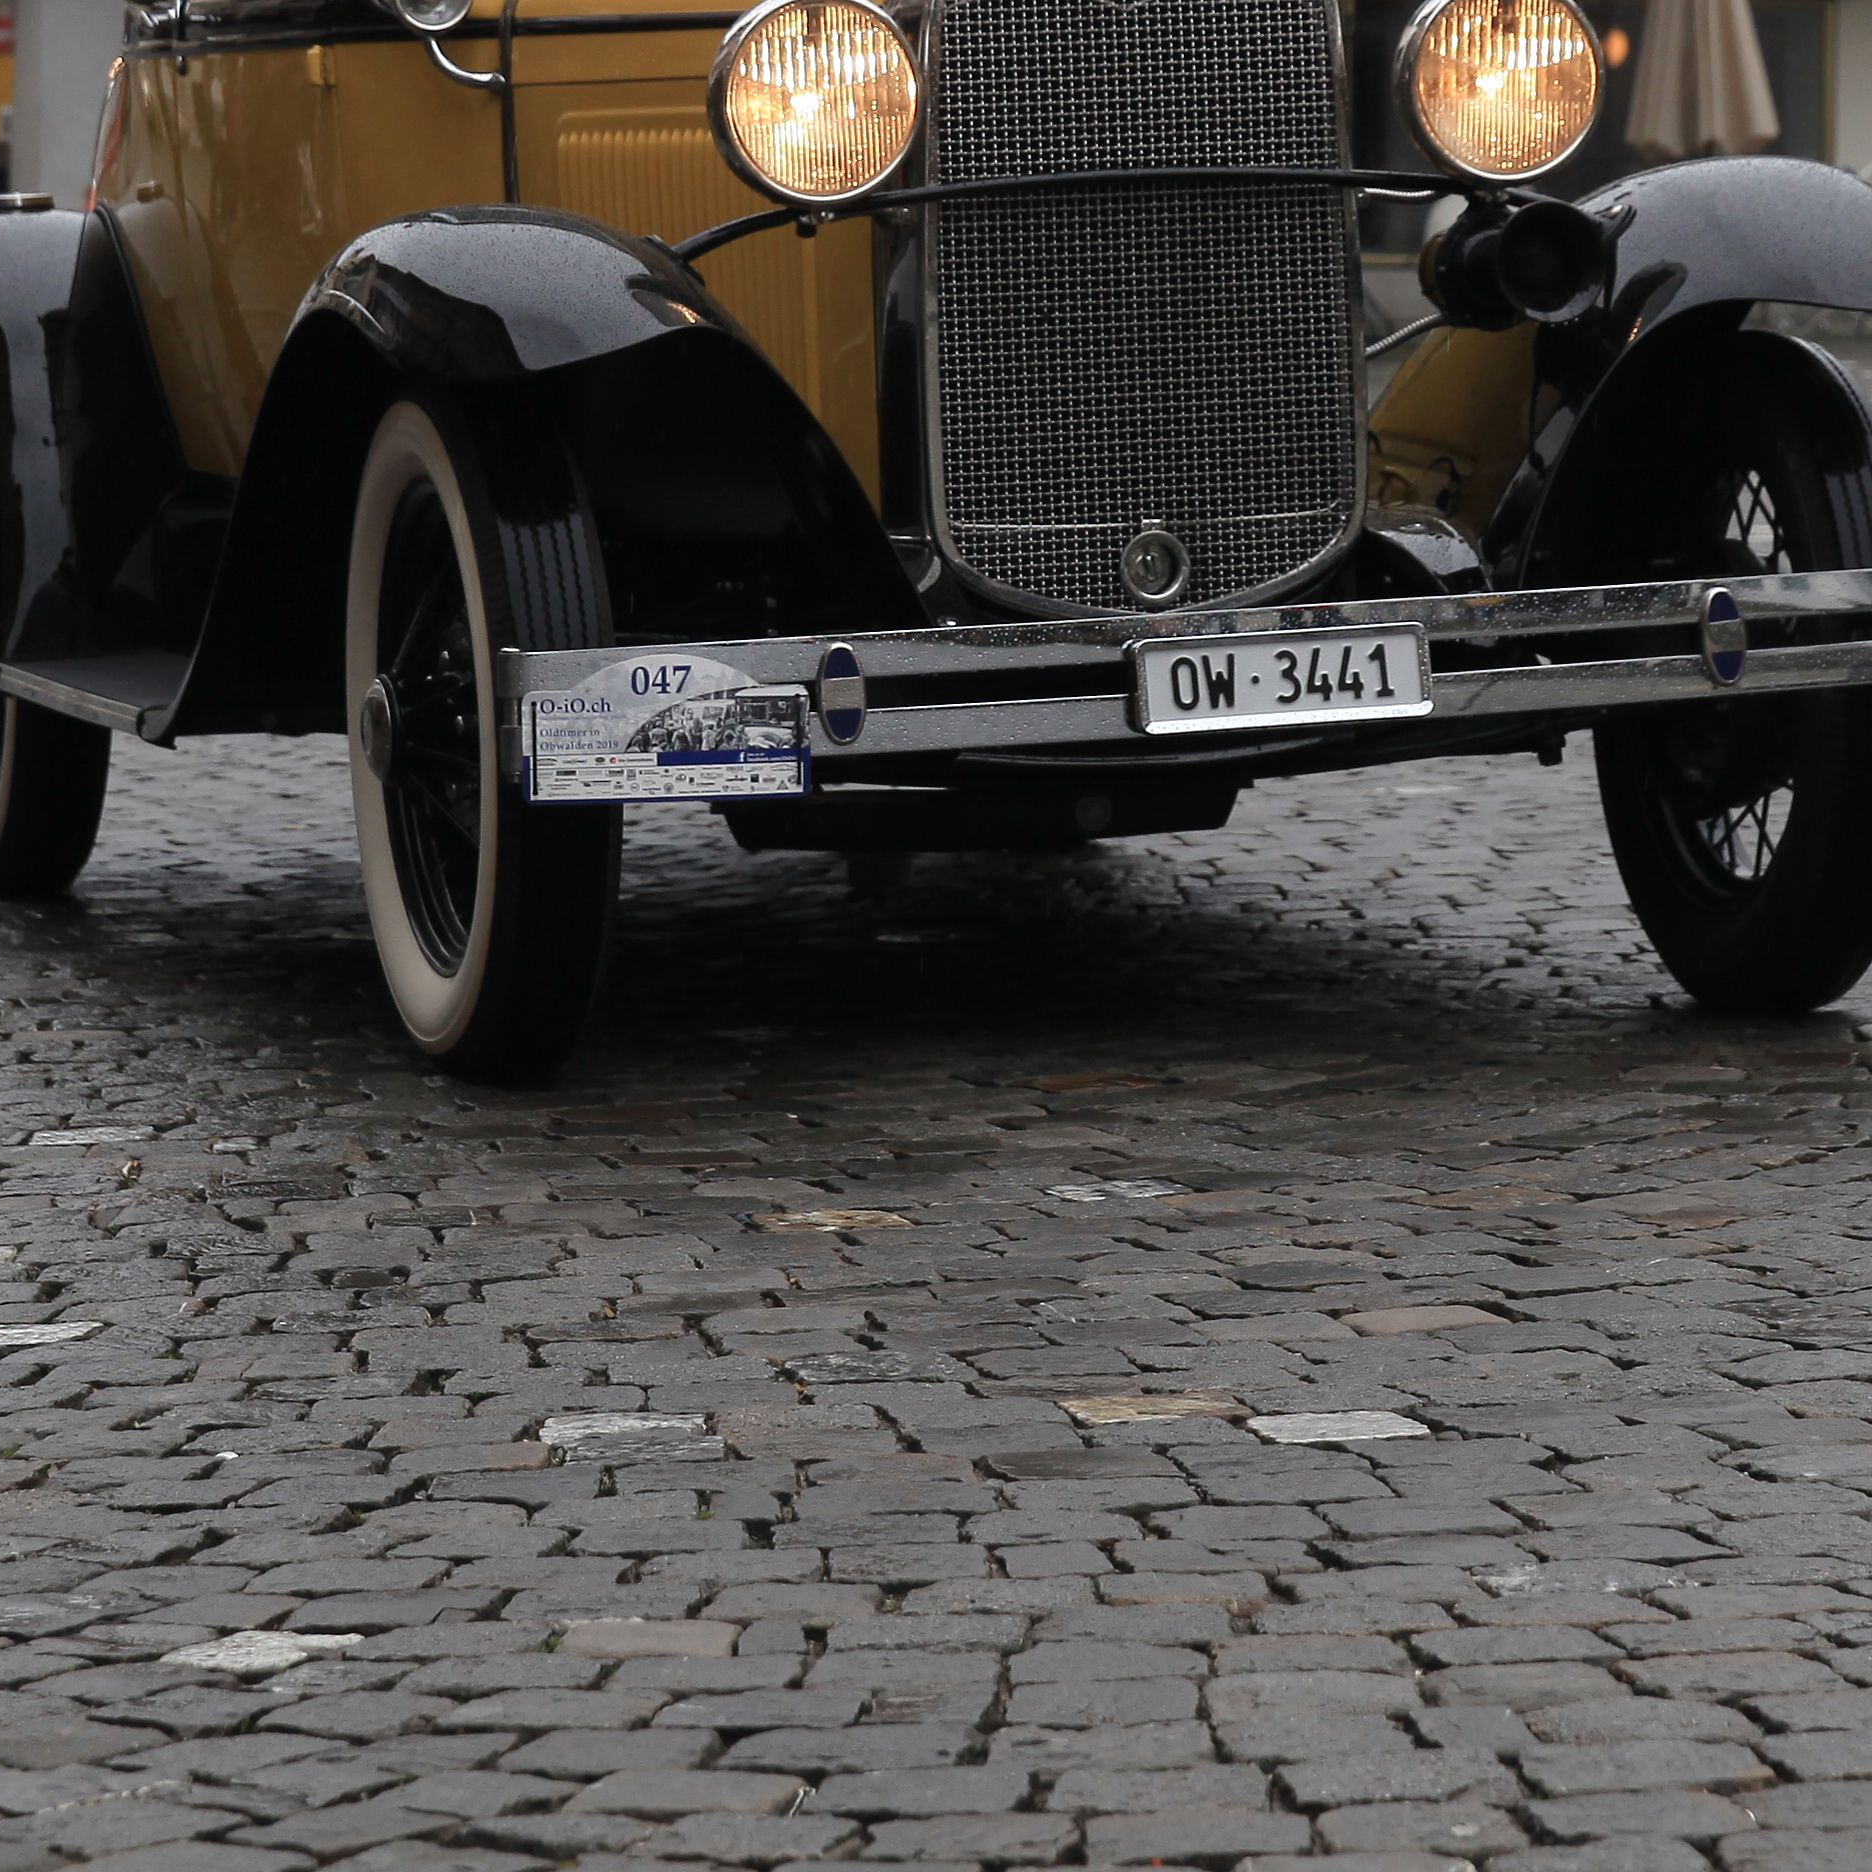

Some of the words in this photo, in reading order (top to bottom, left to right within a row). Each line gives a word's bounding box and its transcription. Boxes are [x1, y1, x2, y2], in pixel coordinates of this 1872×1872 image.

[630, 665, 692, 695] 047
[1171, 652, 1235, 711] OW
[1274, 643, 1395, 704] 3441
[539, 697, 611, 715] O-iO.ch
[540, 728, 587, 738] Oldtimer
[590, 728, 600, 736] in
[540, 742, 593, 751] Obwalden
[596, 740, 619, 750] 2019
